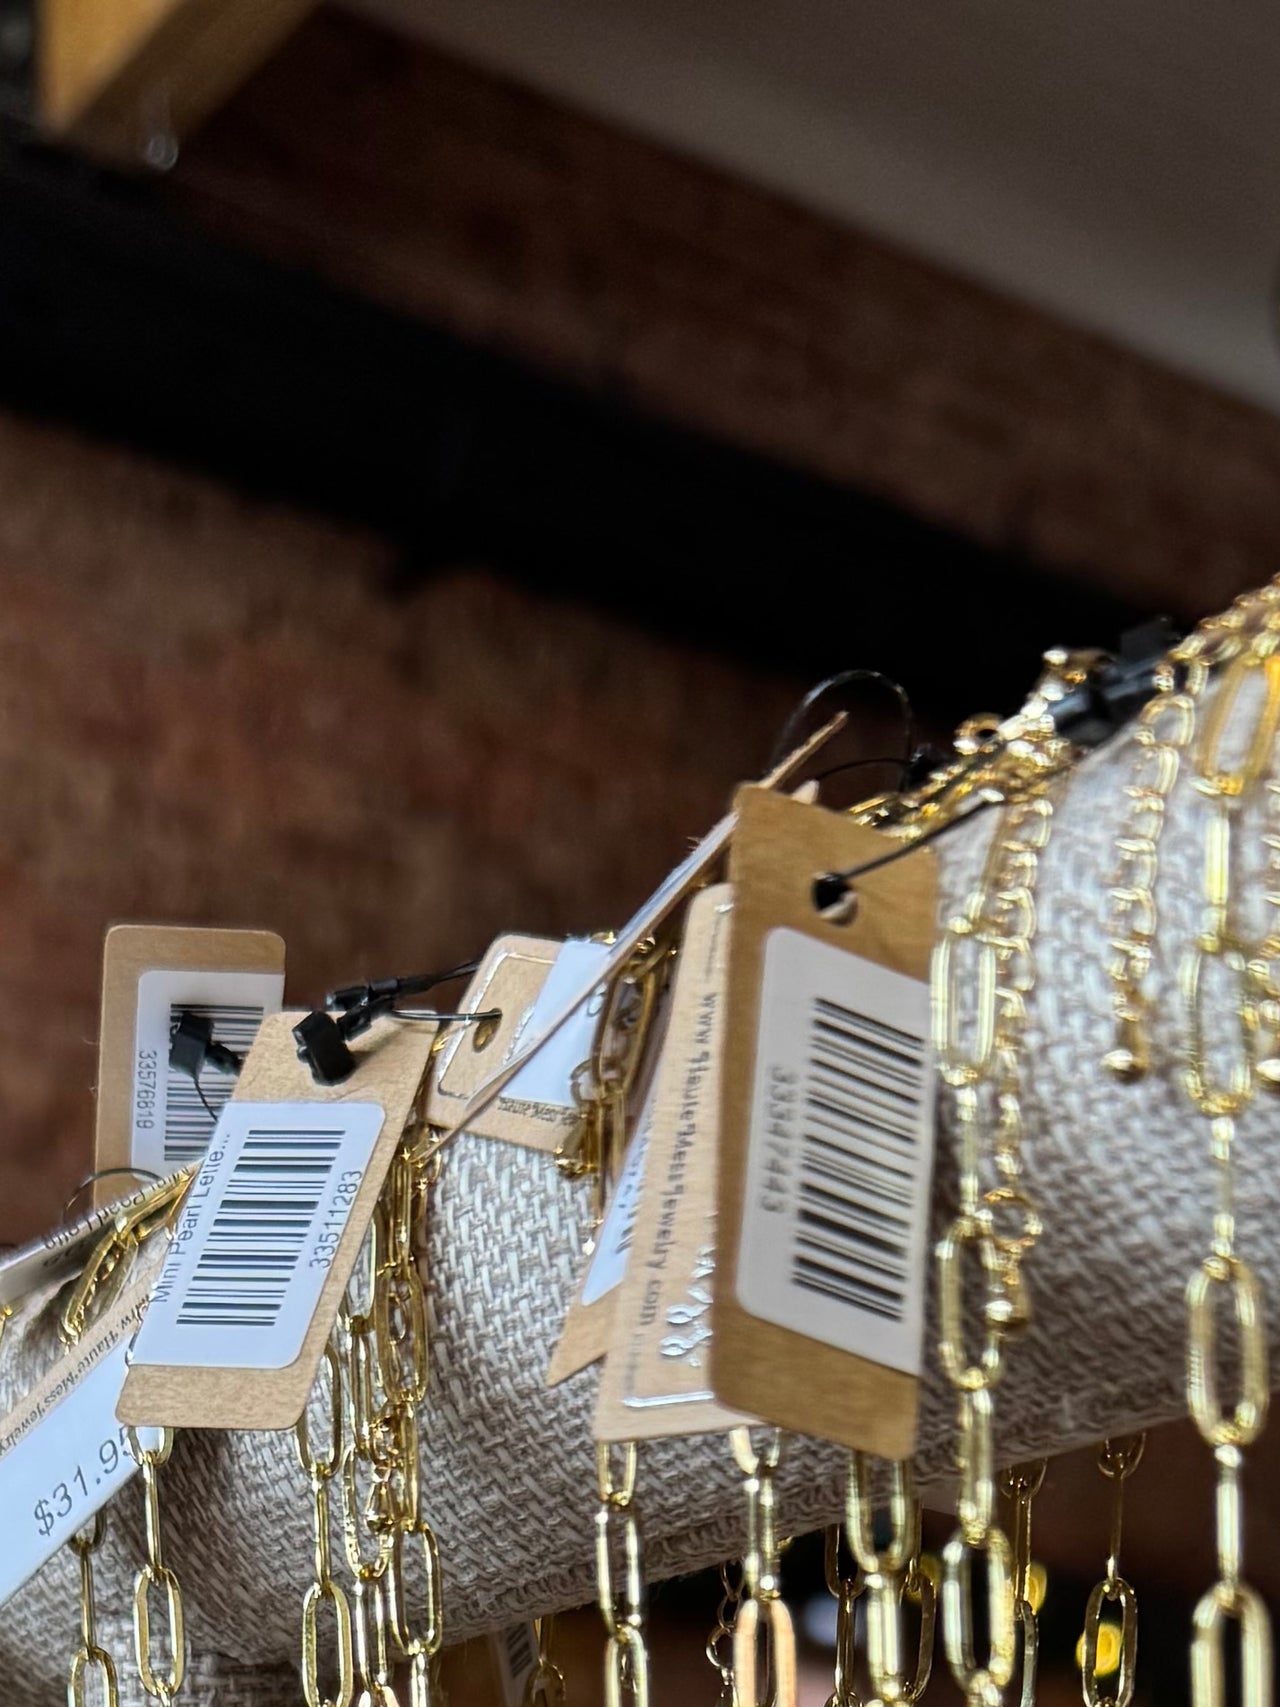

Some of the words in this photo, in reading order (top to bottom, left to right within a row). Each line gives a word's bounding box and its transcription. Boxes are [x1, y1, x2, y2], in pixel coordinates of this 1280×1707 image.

[136, 1049, 158, 1130] 33576819
[170, 1206, 200, 1255] Pearl
[309, 1170, 363, 1269] 33511283
